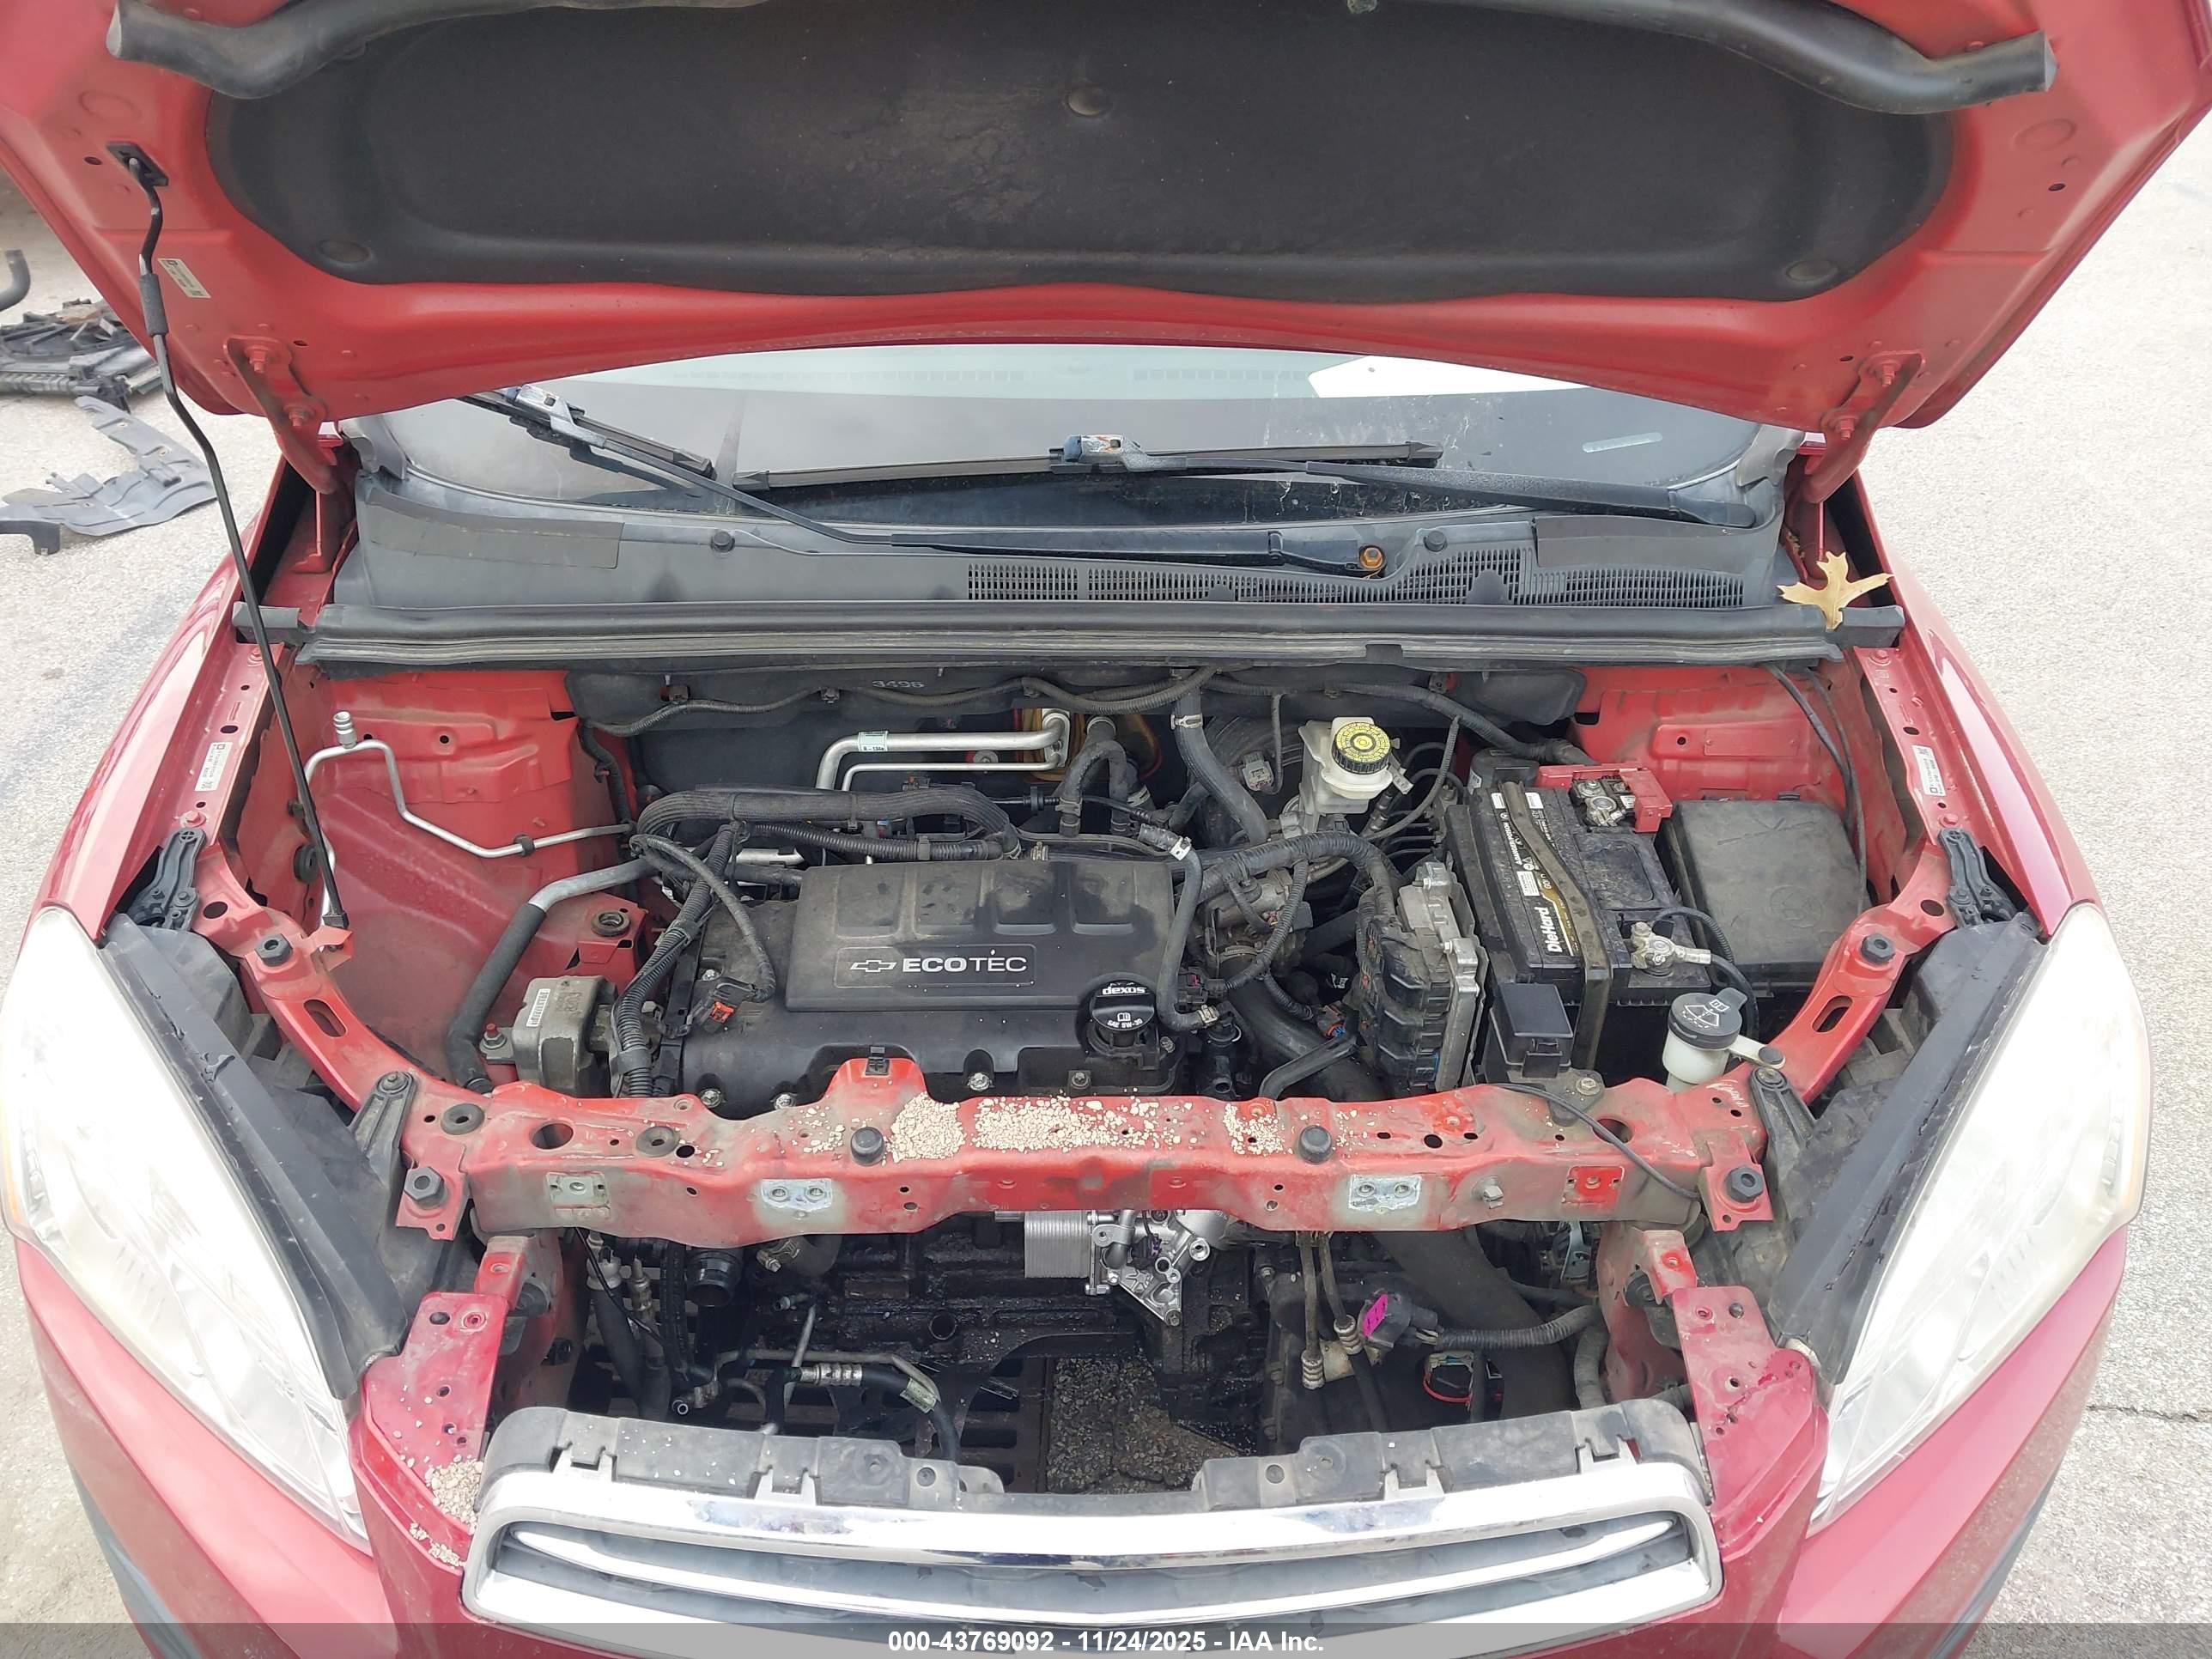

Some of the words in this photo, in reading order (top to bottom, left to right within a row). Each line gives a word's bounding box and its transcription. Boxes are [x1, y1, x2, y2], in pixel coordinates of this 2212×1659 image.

[1534, 906, 1563, 953] DieHard
[902, 956, 1028, 973] ECOTEC
[1102, 985, 1147, 995] dexos
[1107, 1019, 1121, 1028] SAE
[1121, 1018, 1144, 1029] 5W-30
